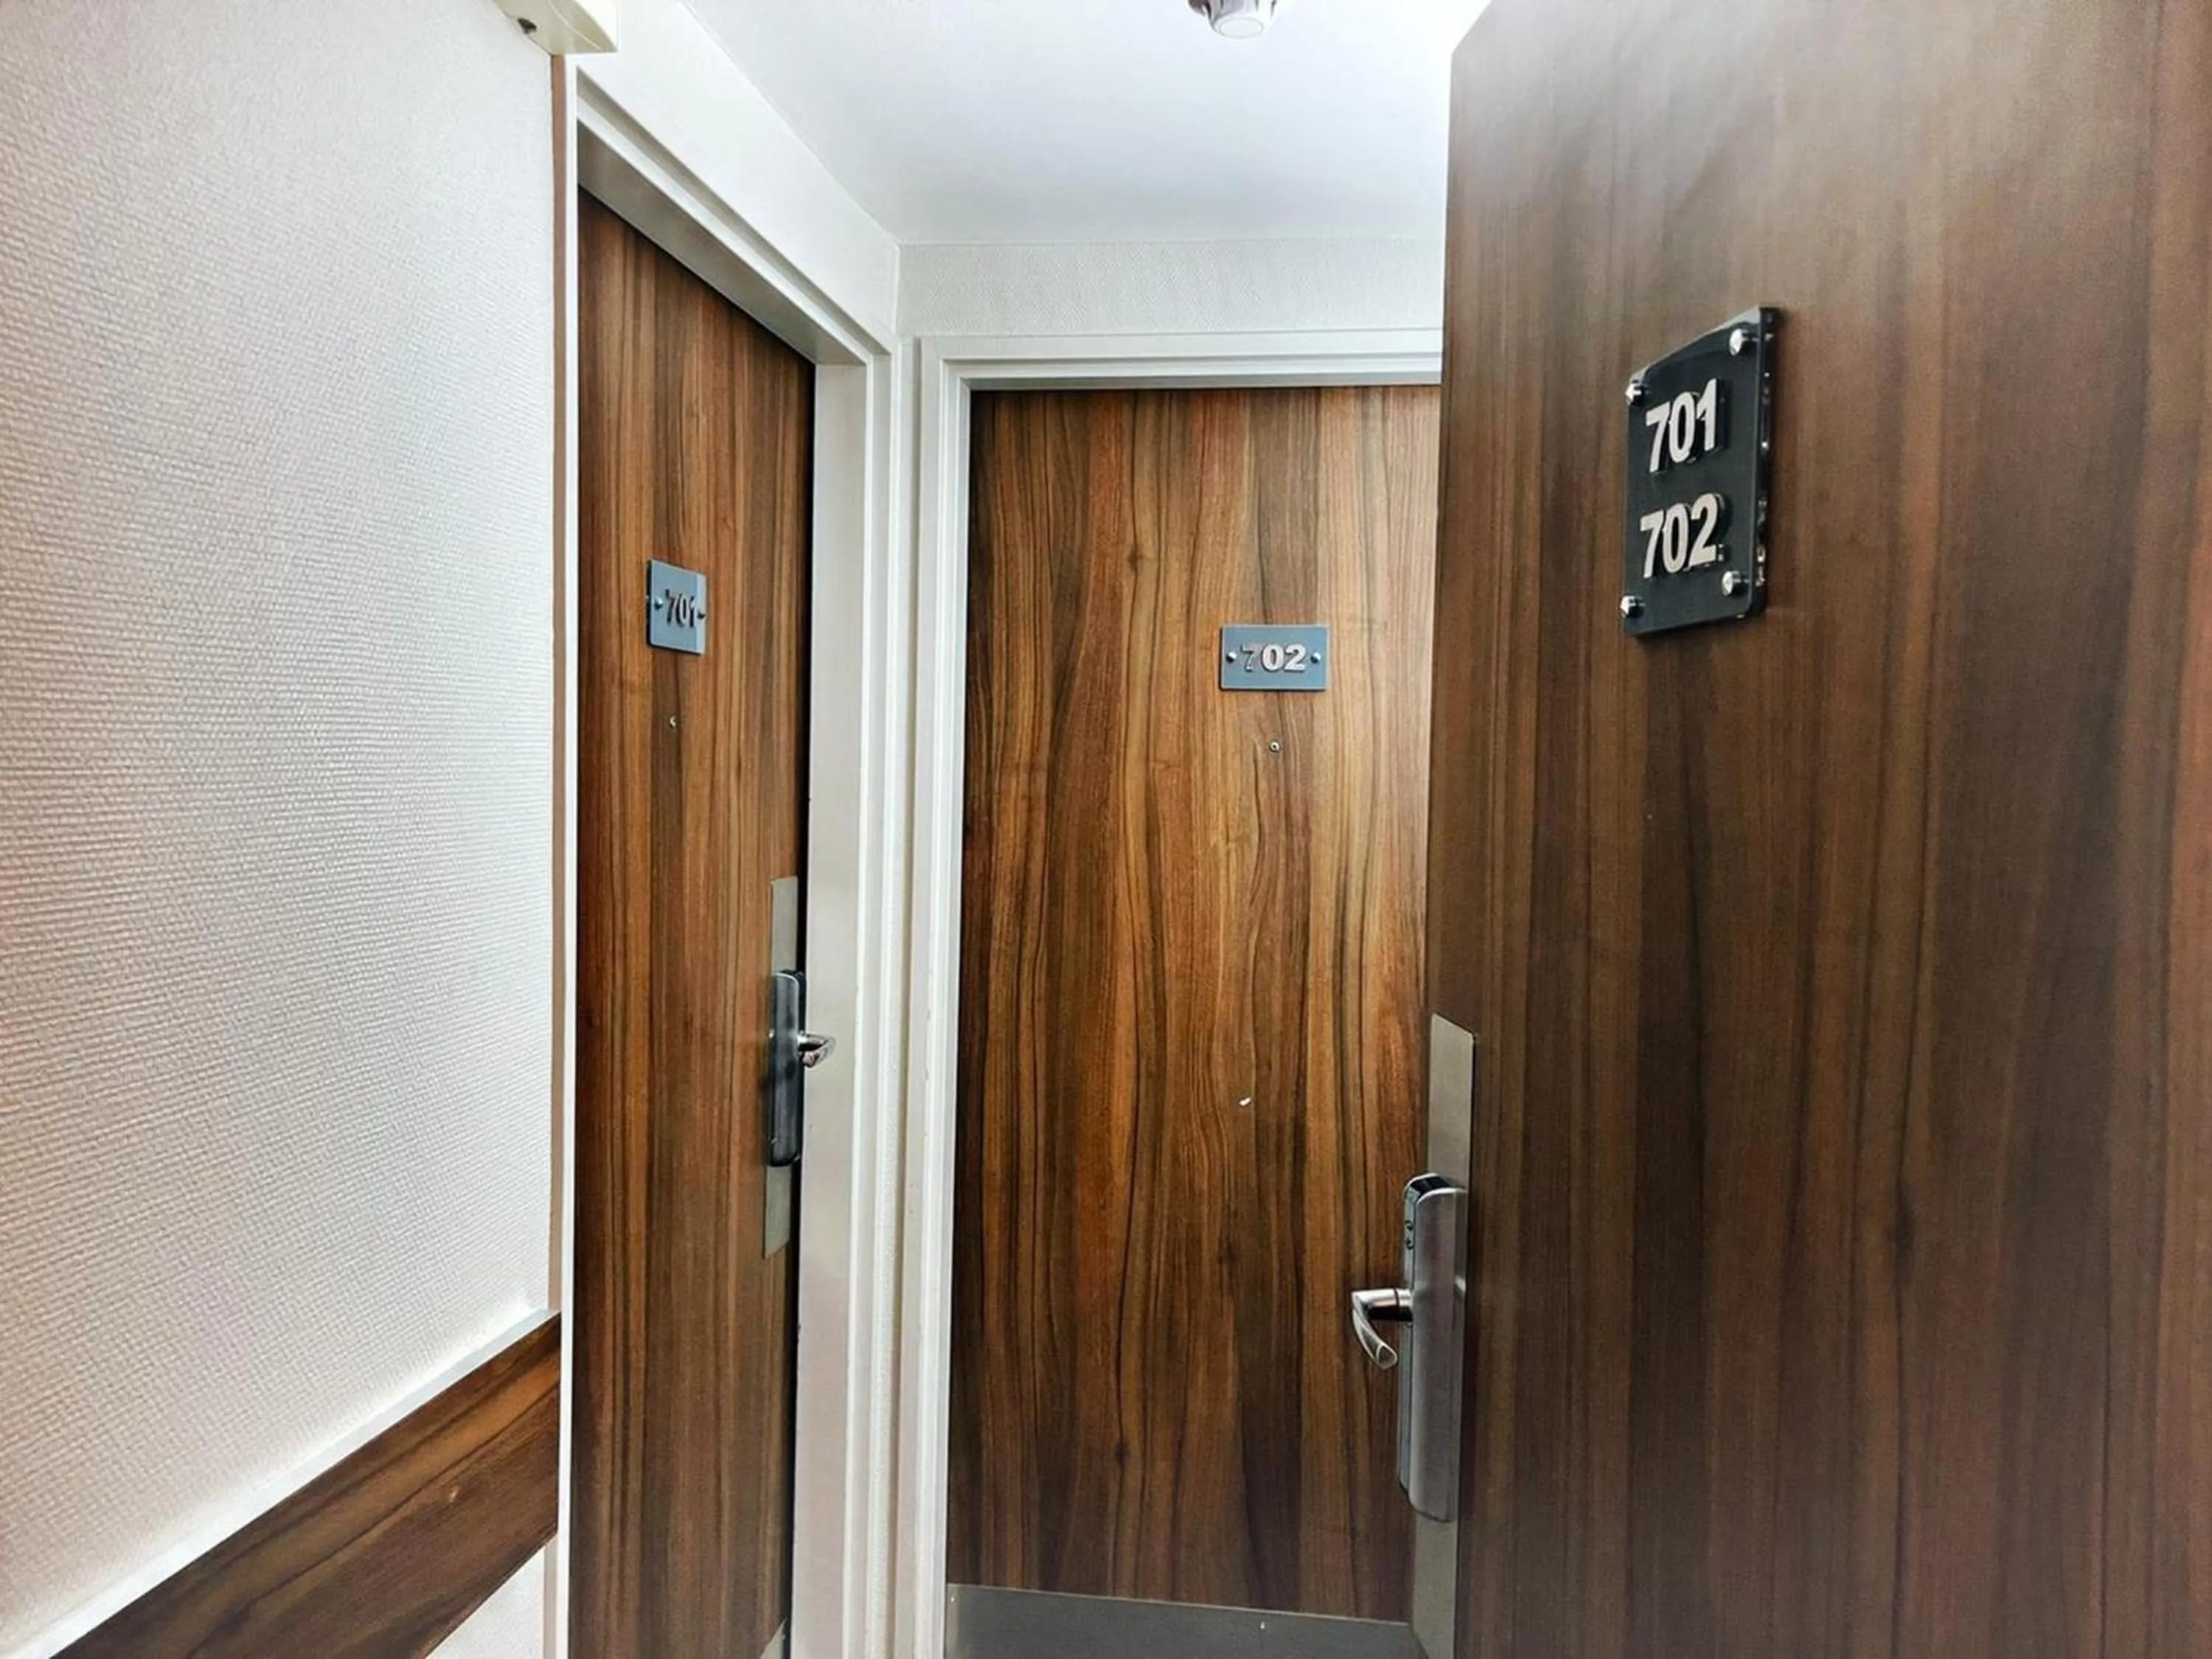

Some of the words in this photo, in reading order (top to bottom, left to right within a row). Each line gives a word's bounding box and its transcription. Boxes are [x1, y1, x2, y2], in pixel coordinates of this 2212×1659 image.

[1646, 378, 1717, 473] 701
[1640, 493, 1718, 578] 702
[664, 588, 695, 627] 701
[1240, 643, 1307, 672] 702
